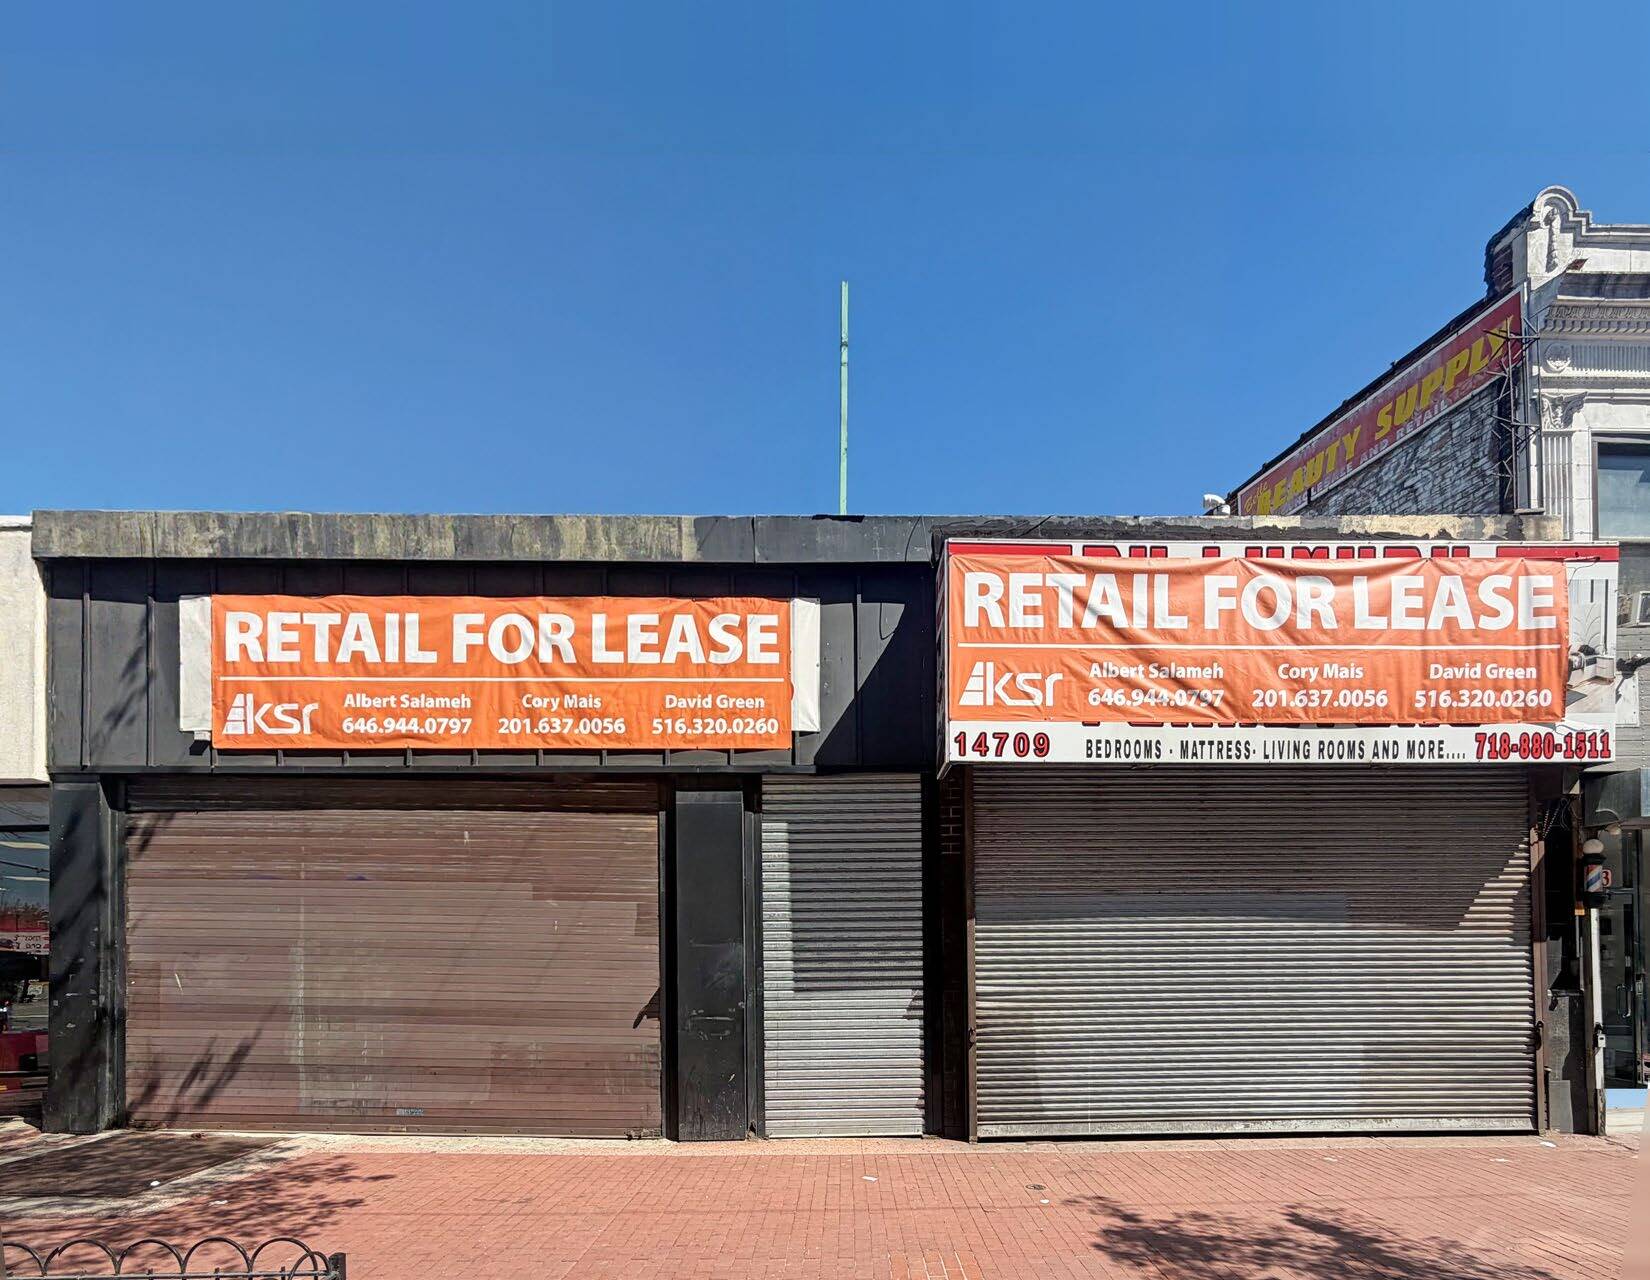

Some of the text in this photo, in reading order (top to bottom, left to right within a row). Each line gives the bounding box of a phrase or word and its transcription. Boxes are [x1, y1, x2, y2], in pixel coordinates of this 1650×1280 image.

[1375, 315, 1514, 441] SUPPLY
[963, 571, 1557, 631] RETAIL FOR LEASE
[225, 612, 780, 665] RETAIL FOR LEASE
[1089, 662, 1224, 679] Albert Salameh
[1277, 663, 1364, 682] Cory Mais
[1429, 663, 1537, 680] David Green
[986, 661, 1064, 707] ksr
[344, 693, 471, 709] Albert Salameh
[522, 694, 602, 711] Cory Mais
[665, 694, 765, 709] David Green
[1088, 688, 1225, 708] 646.944.0797
[1252, 688, 1388, 708] 201.637.0056
[1414, 688, 1552, 708] 516.320.0260
[246, 693, 320, 735] ksr
[342, 717, 472, 735] 646.944.0797
[498, 717, 626, 735] 201.637.0056
[652, 717, 779, 735] 516.320.0260
[953, 731, 1051, 757] 14709
[1085, 739, 1162, 759] BEDROOMS
[1263, 740, 1311, 760] LIVING
[1317, 740, 1366, 760] ROOMS
[1371, 740, 1400, 760] AND
[1474, 730, 1612, 760] 718-880-1511
